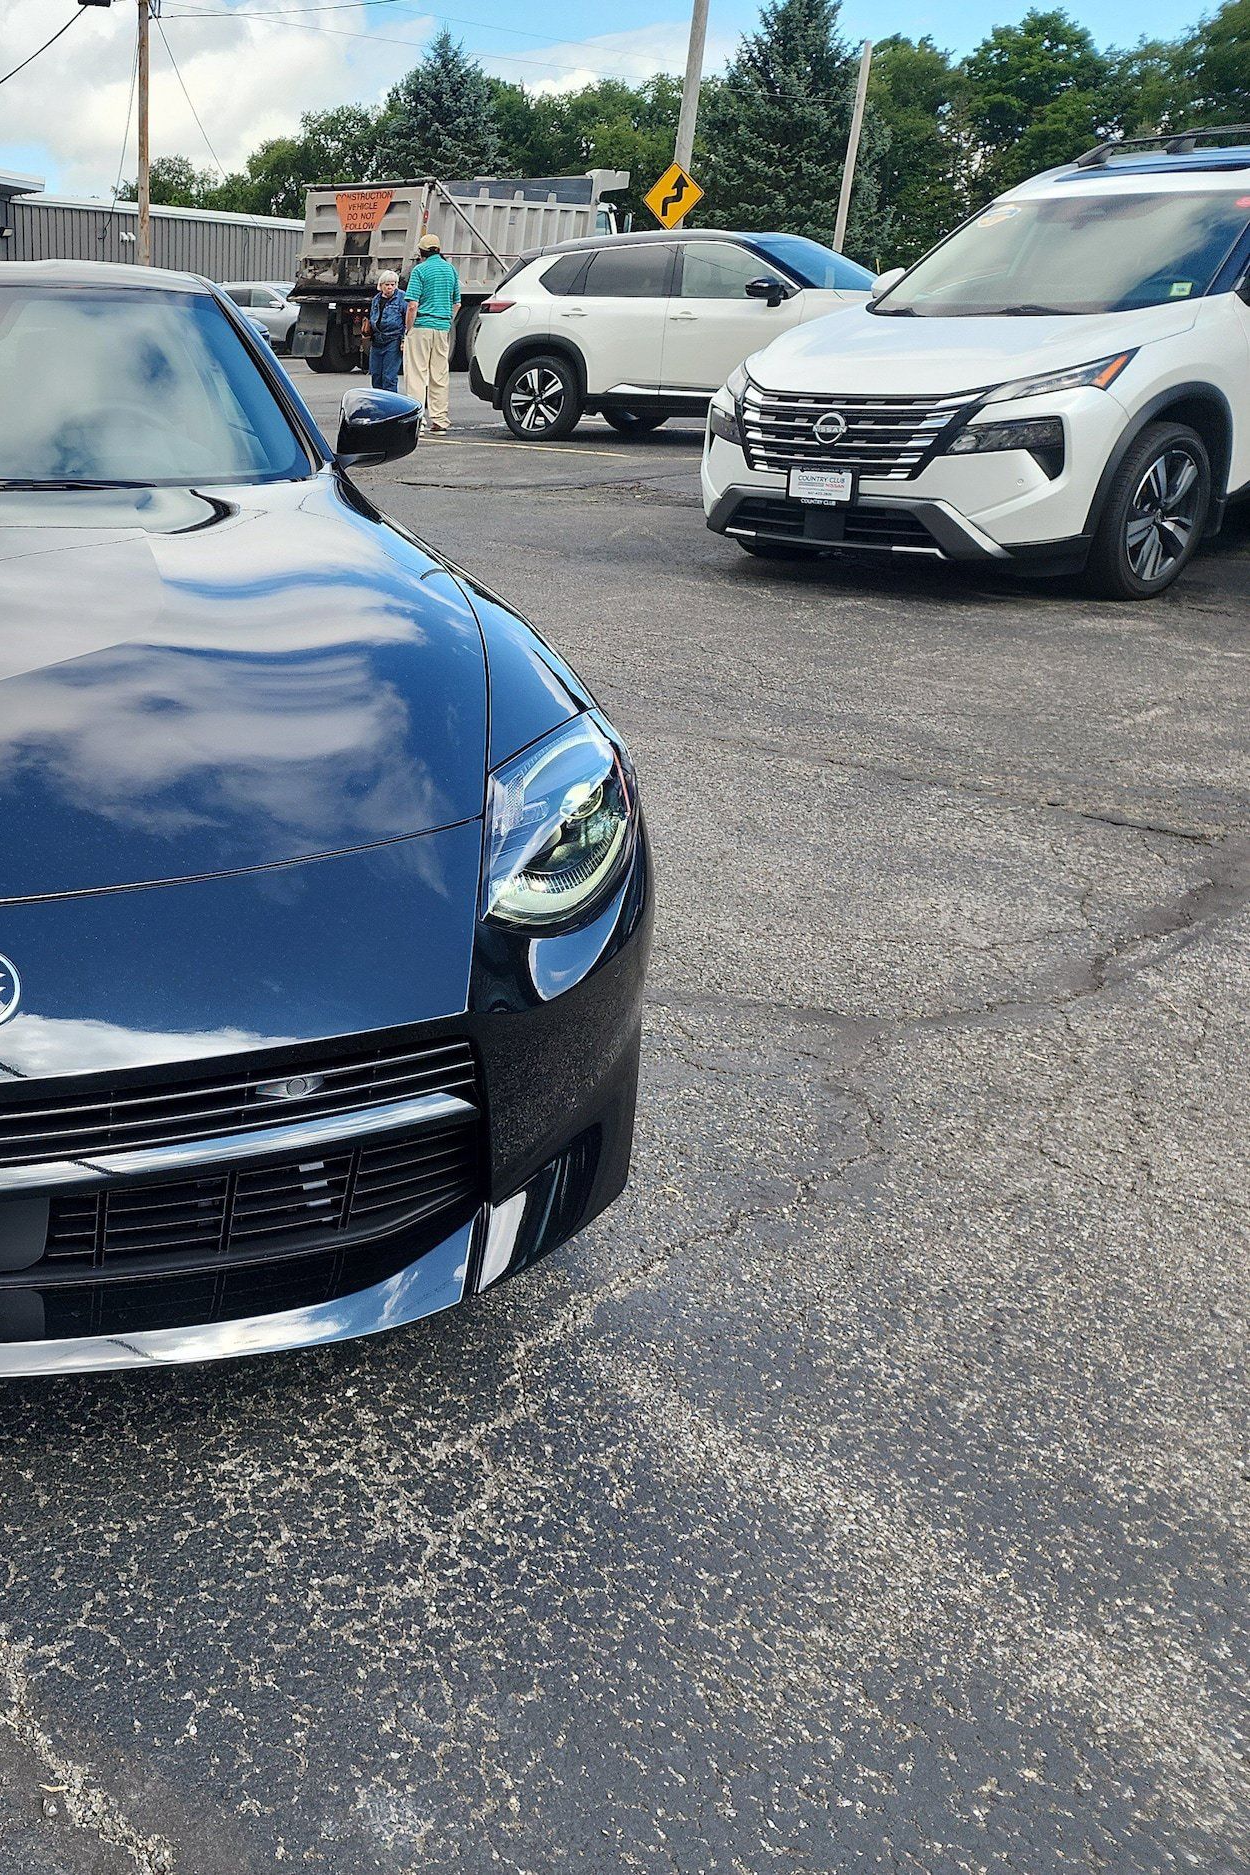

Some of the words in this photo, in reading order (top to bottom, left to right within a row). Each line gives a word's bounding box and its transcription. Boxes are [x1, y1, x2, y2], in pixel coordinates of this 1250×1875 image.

[336, 190, 394, 201] CONSTRUCTION
[348, 202, 378, 211] VEHICLE
[347, 212, 358, 221] DO
[360, 211, 376, 221] NOT
[344, 222, 376, 231] FOLLOW
[813, 425, 848, 434] NISSAN
[798, 475, 828, 483] COUNTRY
[829, 476, 846, 484] CLUB
